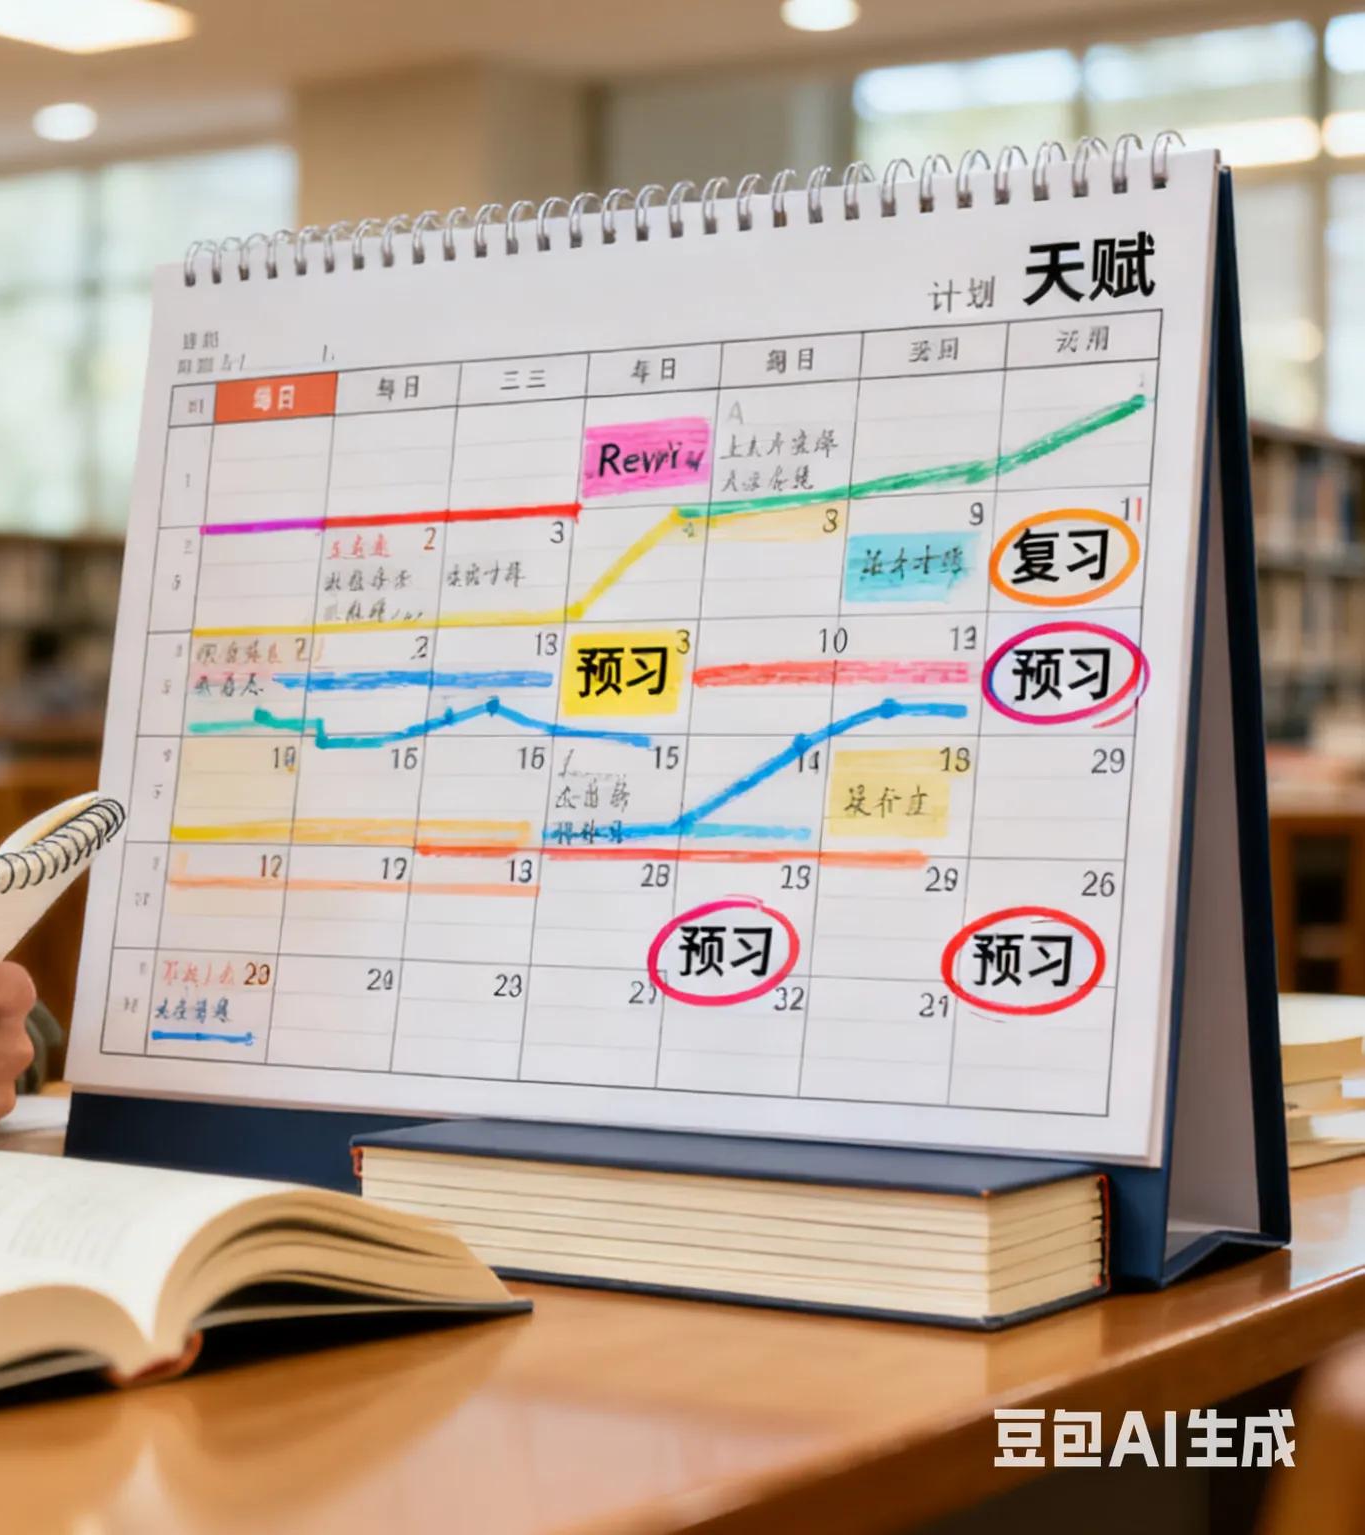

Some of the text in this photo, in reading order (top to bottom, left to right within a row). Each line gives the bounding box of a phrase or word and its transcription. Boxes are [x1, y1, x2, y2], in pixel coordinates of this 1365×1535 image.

[1023, 230, 1156, 306] 天赋
[928, 275, 996, 313] 计划
[969, 501, 984, 526] 9
[549, 520, 565, 544] 3
[1011, 528, 1110, 584] 复习
[534, 632, 559, 656] 13
[676, 629, 691, 655] 3
[819, 627, 849, 654] 10
[576, 646, 669, 698] 预习
[1012, 647, 1111, 701] 预习
[651, 745, 679, 769] 15
[1091, 747, 1125, 774] 29
[1081, 870, 1115, 897] 26
[679, 925, 773, 977] 预习
[973, 933, 1073, 987] 预习
